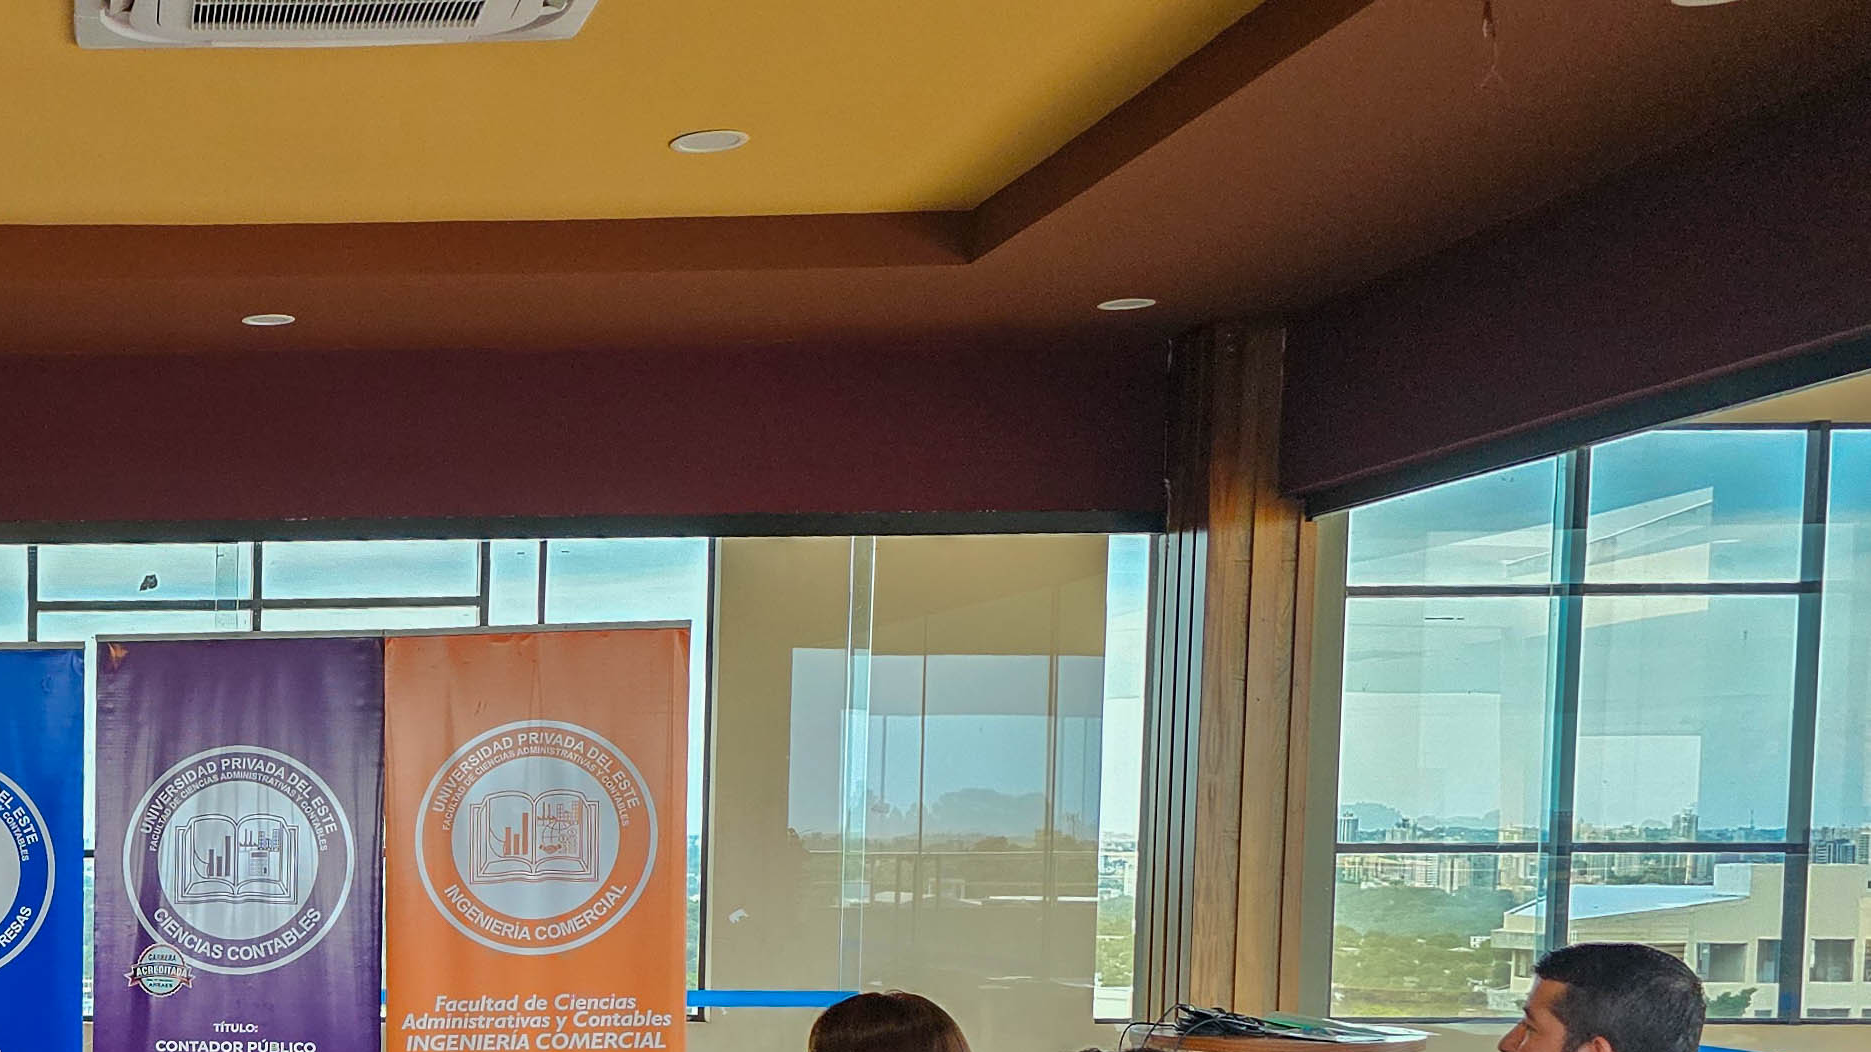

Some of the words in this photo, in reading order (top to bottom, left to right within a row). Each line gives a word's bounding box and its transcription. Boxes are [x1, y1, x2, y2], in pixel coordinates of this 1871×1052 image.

[140, 761, 217, 834] UNIVERSIDAD
[220, 757, 285, 779] PRIVADA
[287, 772, 313, 798] DEL
[311, 796, 338, 834] ESTE
[432, 736, 513, 812] UNIVERSIDAD
[518, 732, 584, 754] PRIVADA
[587, 747, 613, 773] DEL
[612, 770, 640, 809] ESTE
[442, 785, 466, 831] FACULTAD
[464, 775, 475, 786] DE
[474, 750, 516, 775] CIENCIAS
[517, 745, 597, 771] ADMINISTRATIVAS
[596, 768, 604, 777] Y
[601, 775, 630, 826] CONTABLES
[2, 811, 29, 861] CONTABLES
[12, 806, 39, 845] ESTE
[149, 808, 171, 852] FACULTAD
[169, 797, 181, 809] DE
[180, 774, 219, 798] CIENCIAS
[220, 770, 297, 797] ADMINISTRATIVAS
[295, 794, 303, 802] Y
[301, 801, 327, 851] CONTABLES
[153, 907, 223, 959] CIENCIAS
[227, 908, 321, 961] CONTABLES
[444, 884, 531, 941] INGENIERÍA
[535, 883, 628, 941] COMERCIAL
[213, 1021, 258, 1033] TÍTULO:
[402, 1013, 551, 1030] Administrativas
[555, 1015, 568, 1032] y
[573, 1011, 672, 1028] Contables
[435, 995, 517, 1012] Facultad
[524, 995, 547, 1011] de
[554, 993, 636, 1011] Ciencias
[155, 1040, 243, 1052] CONTADOR
[406, 1030, 530, 1052] INGENIERÍA
[536, 1032, 667, 1050] COMERCIAL
